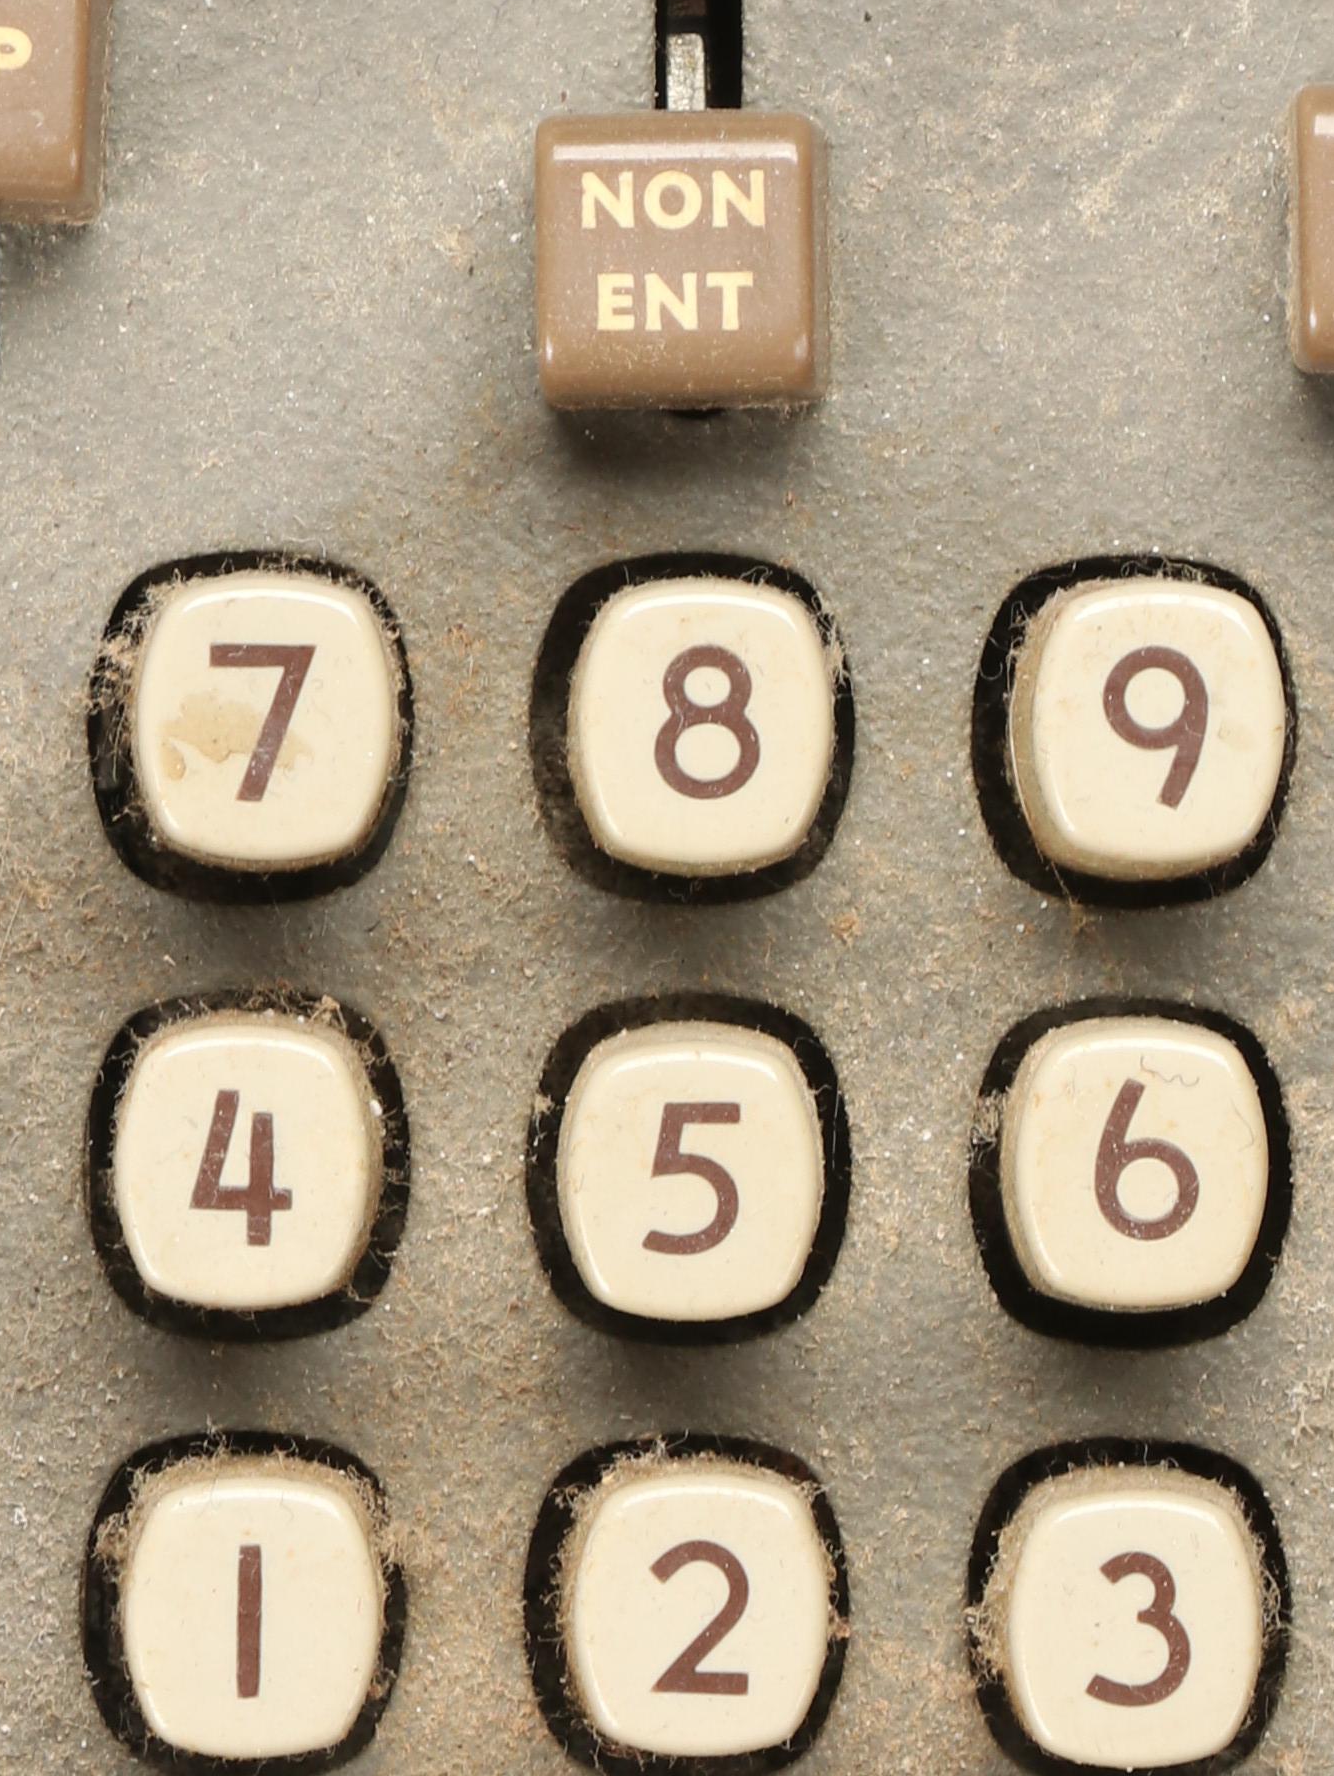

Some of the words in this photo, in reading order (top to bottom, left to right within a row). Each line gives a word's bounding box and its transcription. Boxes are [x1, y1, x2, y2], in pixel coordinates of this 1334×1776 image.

[580, 171, 768, 230] NON
[598, 272, 752, 330] ENT
[210, 643, 316, 801] 7
[654, 643, 760, 799] 8
[1103, 650, 1209, 808] 9
[190, 1090, 292, 1246] 4
[643, 1102, 741, 1255] 5
[1095, 1085, 1200, 1241] 6
[237, 1545, 262, 1698] 1
[651, 1540, 749, 1695] 2
[1086, 1551, 1191, 1707] 3
